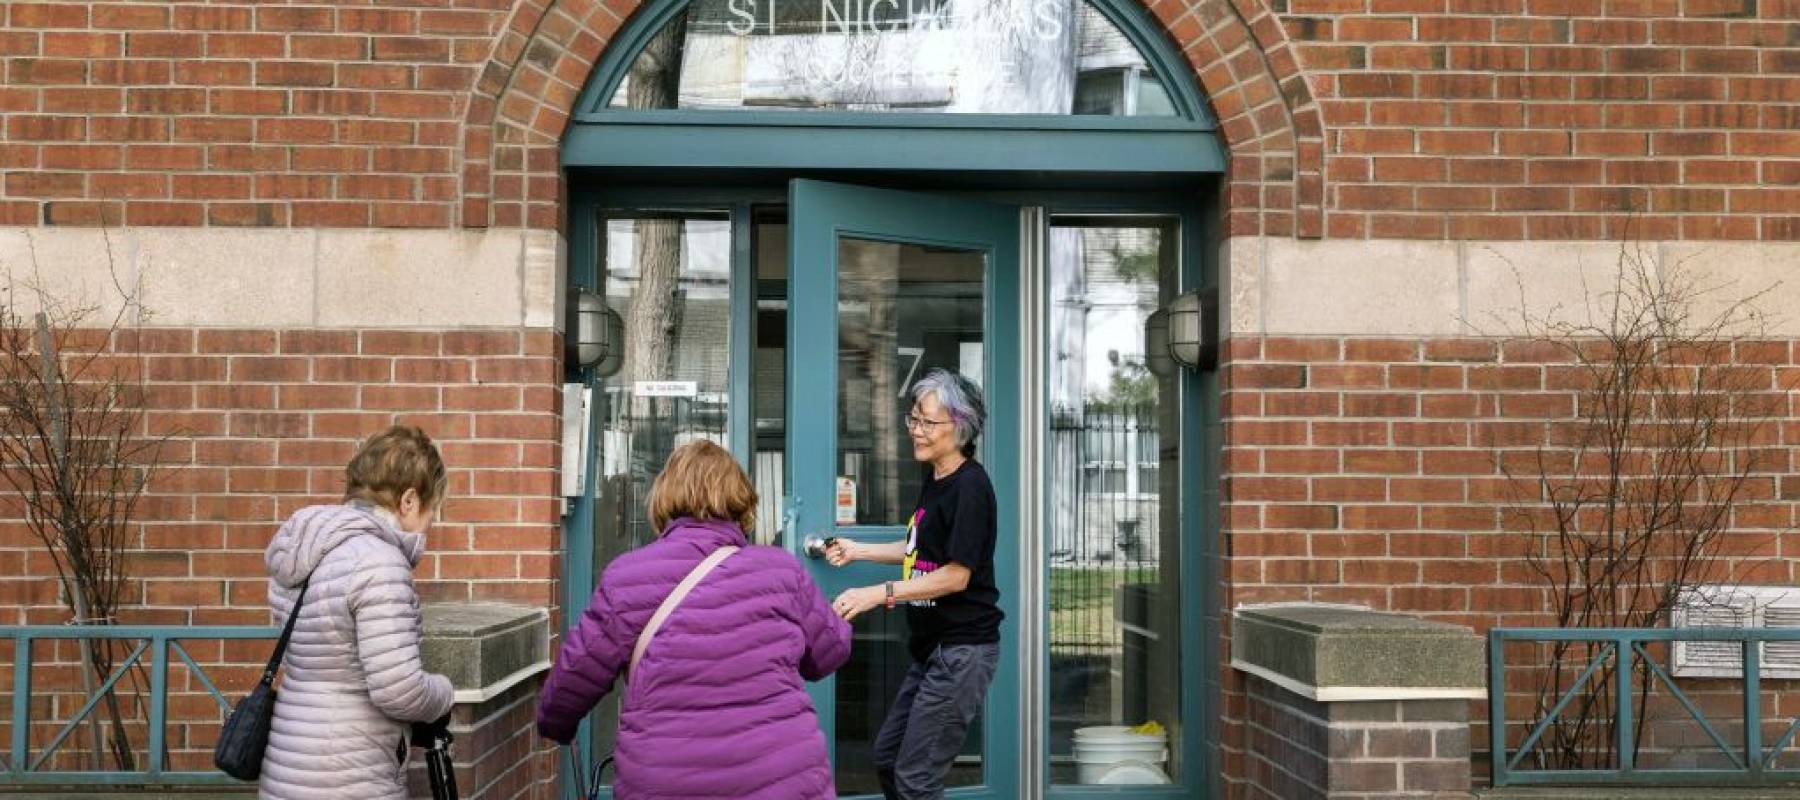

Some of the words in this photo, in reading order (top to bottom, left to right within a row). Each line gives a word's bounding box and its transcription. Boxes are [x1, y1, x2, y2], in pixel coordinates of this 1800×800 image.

[822, 0, 1063, 40] NICHOS
[805, 60, 1016, 87] COOPERE
[897, 347, 926, 398] 7
